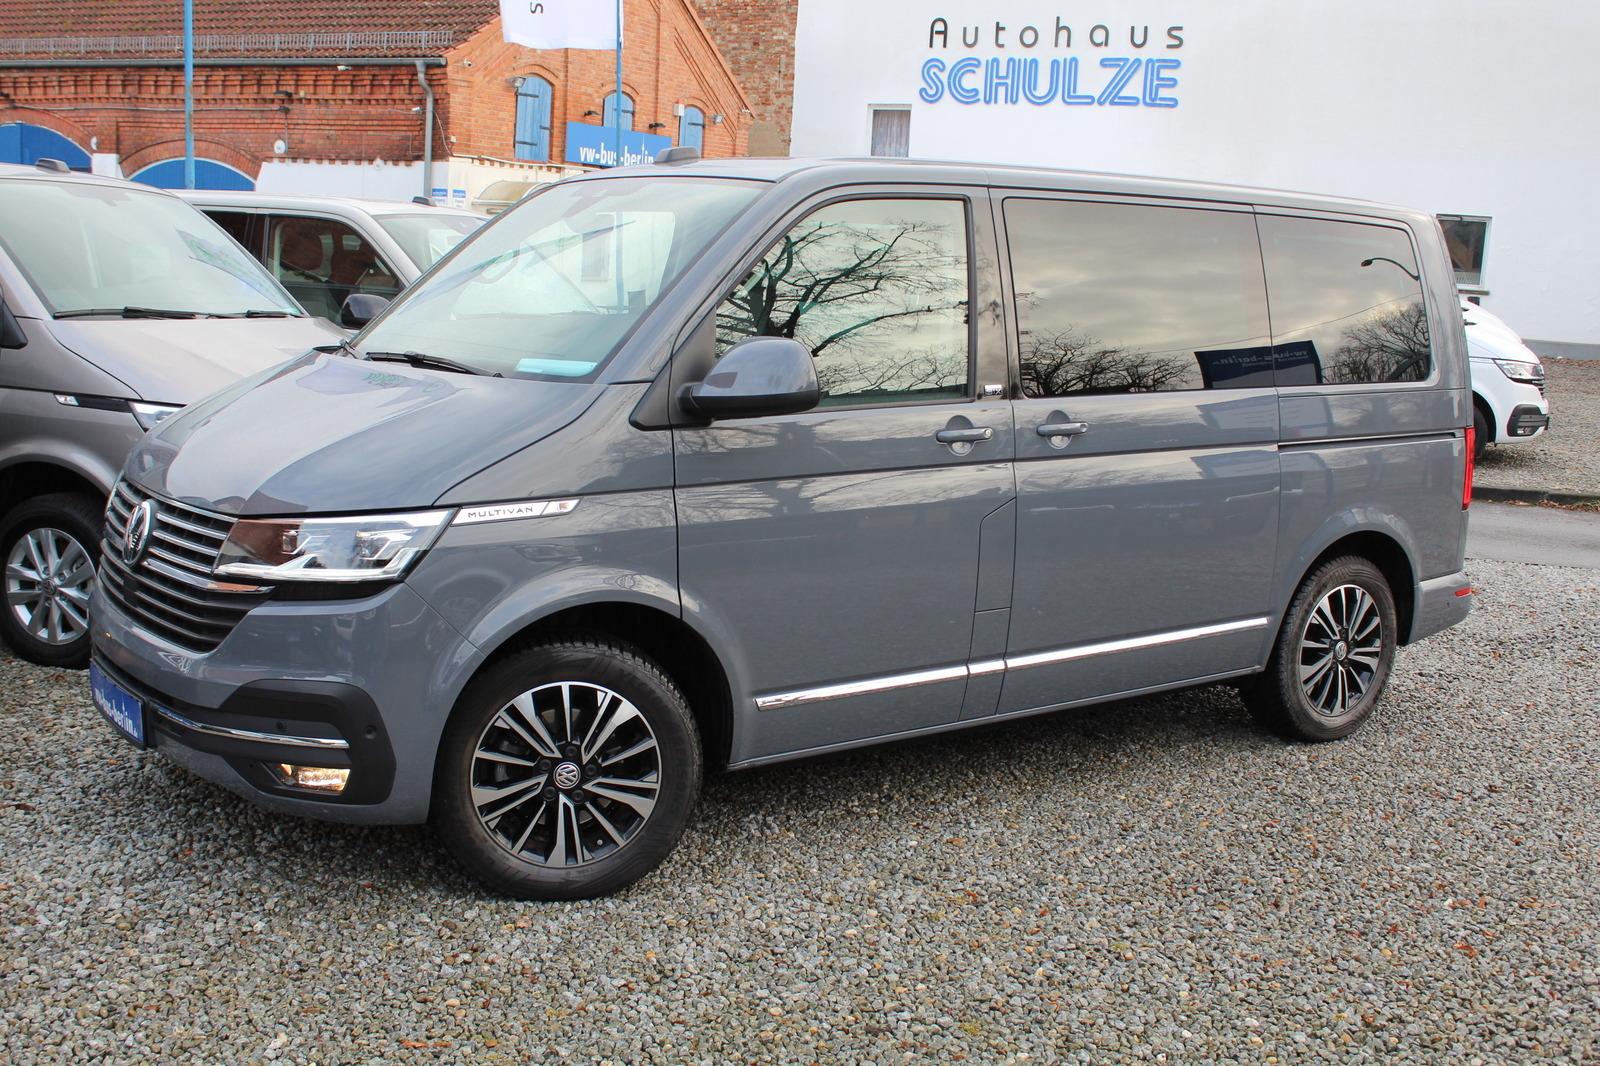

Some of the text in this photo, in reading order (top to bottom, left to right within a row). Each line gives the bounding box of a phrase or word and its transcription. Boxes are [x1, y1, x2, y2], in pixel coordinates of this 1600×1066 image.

[929, 16, 1184, 49] Autohaus
[919, 56, 1181, 108] SCHULZE
[467, 506, 533, 518] MULTIVAN
